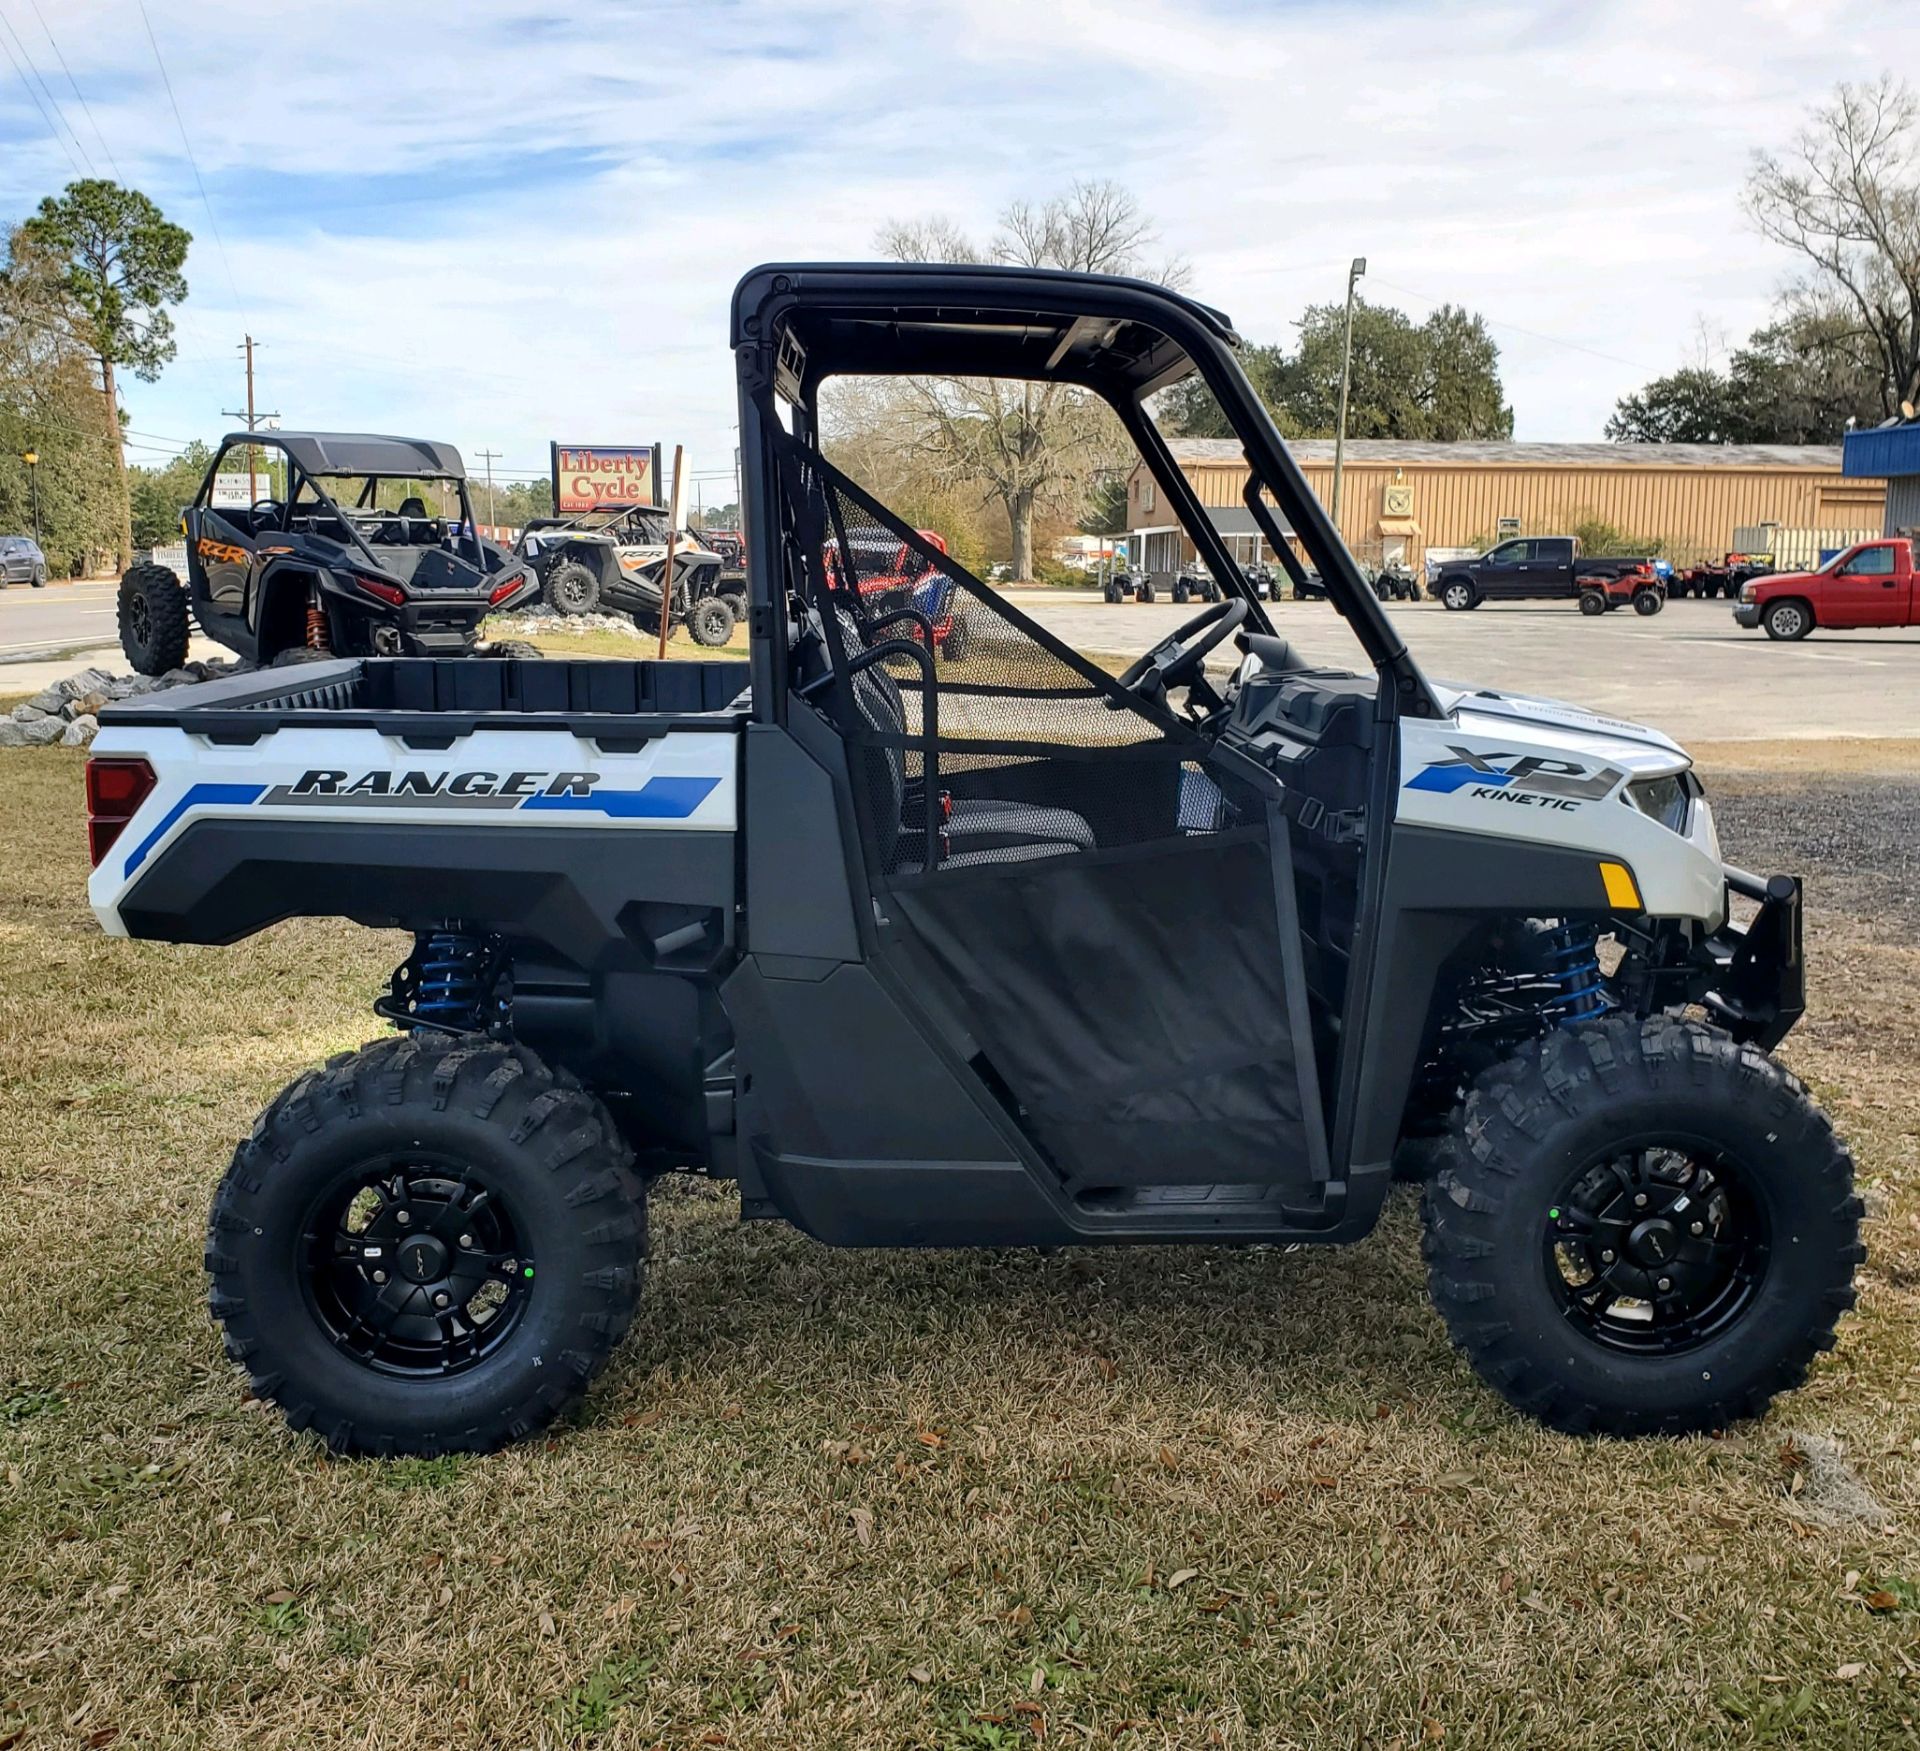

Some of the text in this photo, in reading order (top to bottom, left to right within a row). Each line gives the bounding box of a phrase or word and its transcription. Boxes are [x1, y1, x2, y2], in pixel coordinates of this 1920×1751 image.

[561, 450, 649, 480] Liberty
[571, 476, 639, 502] Cycle
[197, 537, 244, 563] RZR
[1422, 744, 1587, 777] XP
[291, 770, 600, 796] RANGER
[1470, 787, 1582, 812] KINETIC
